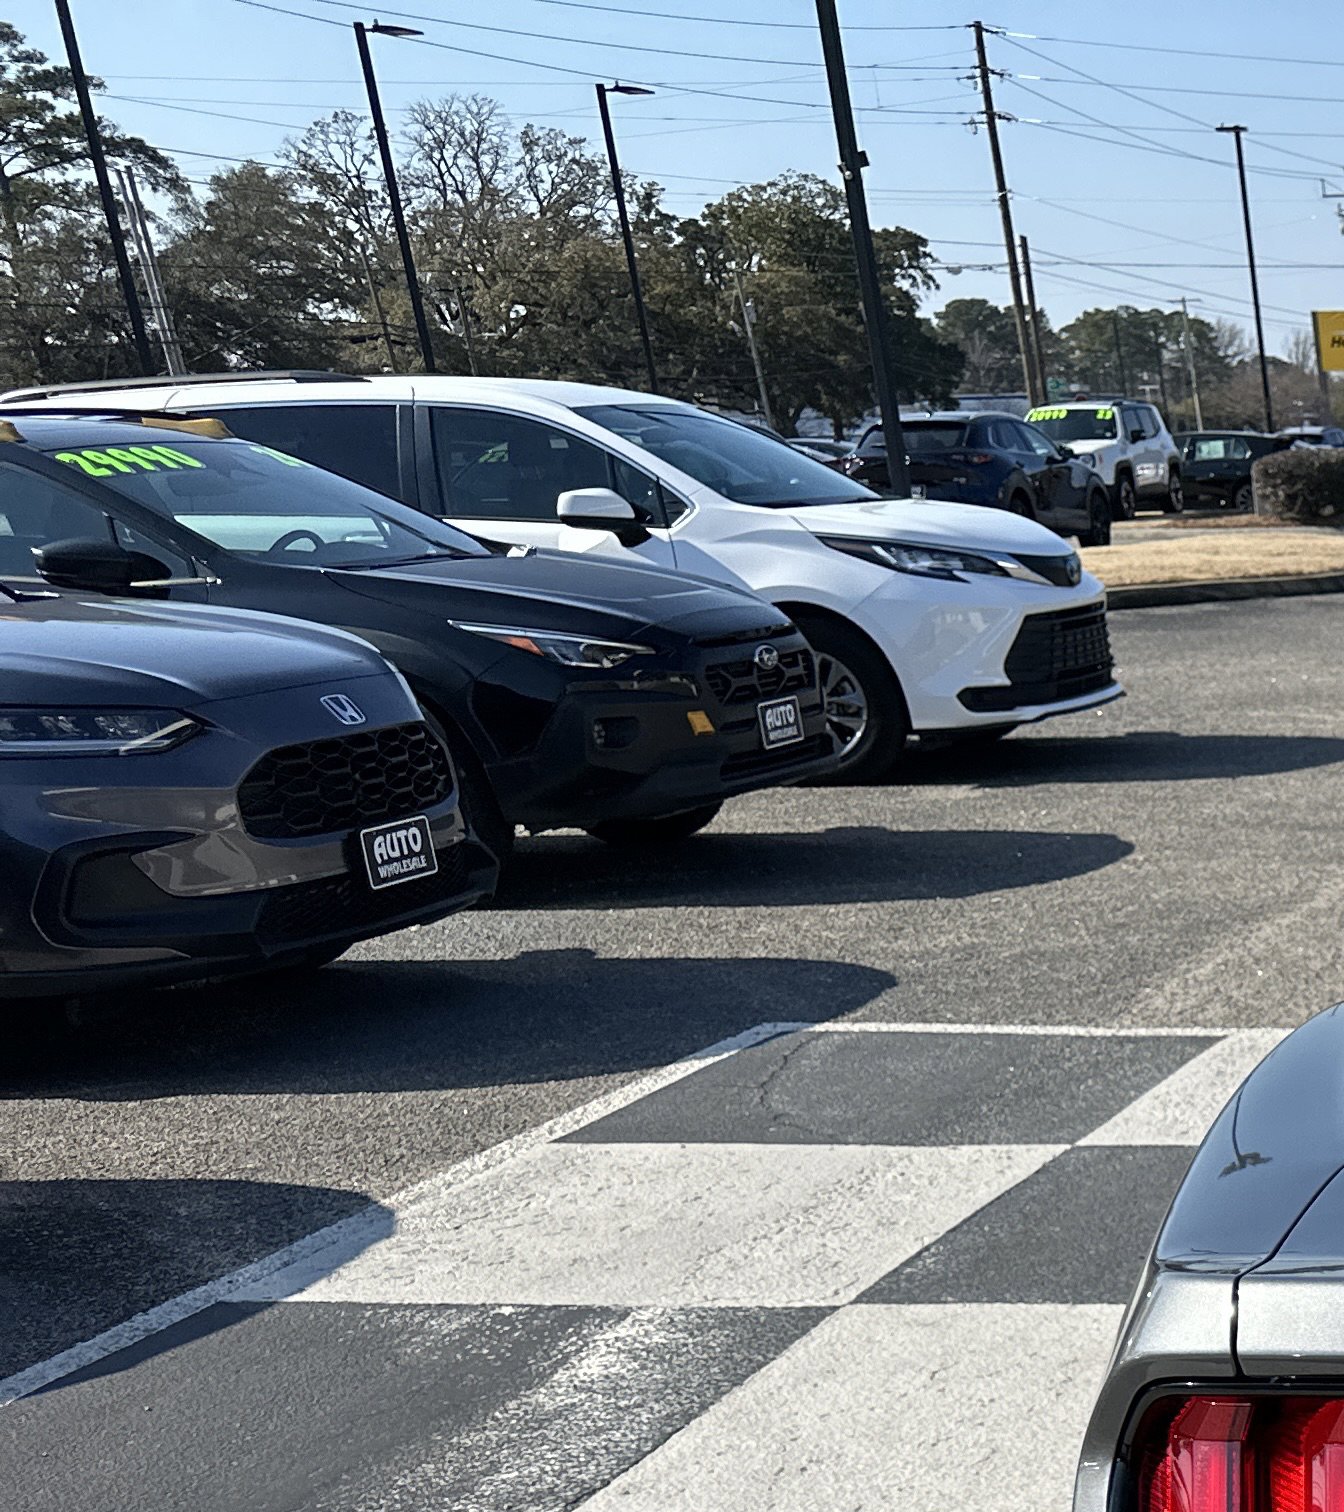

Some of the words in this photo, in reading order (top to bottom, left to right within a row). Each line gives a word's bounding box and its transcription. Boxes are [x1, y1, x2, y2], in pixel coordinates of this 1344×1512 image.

[54, 445, 207, 477] 29990
[766, 704, 796, 730] AUTO
[374, 827, 422, 864] AUTO
[377, 855, 428, 878] WHOLESALE
